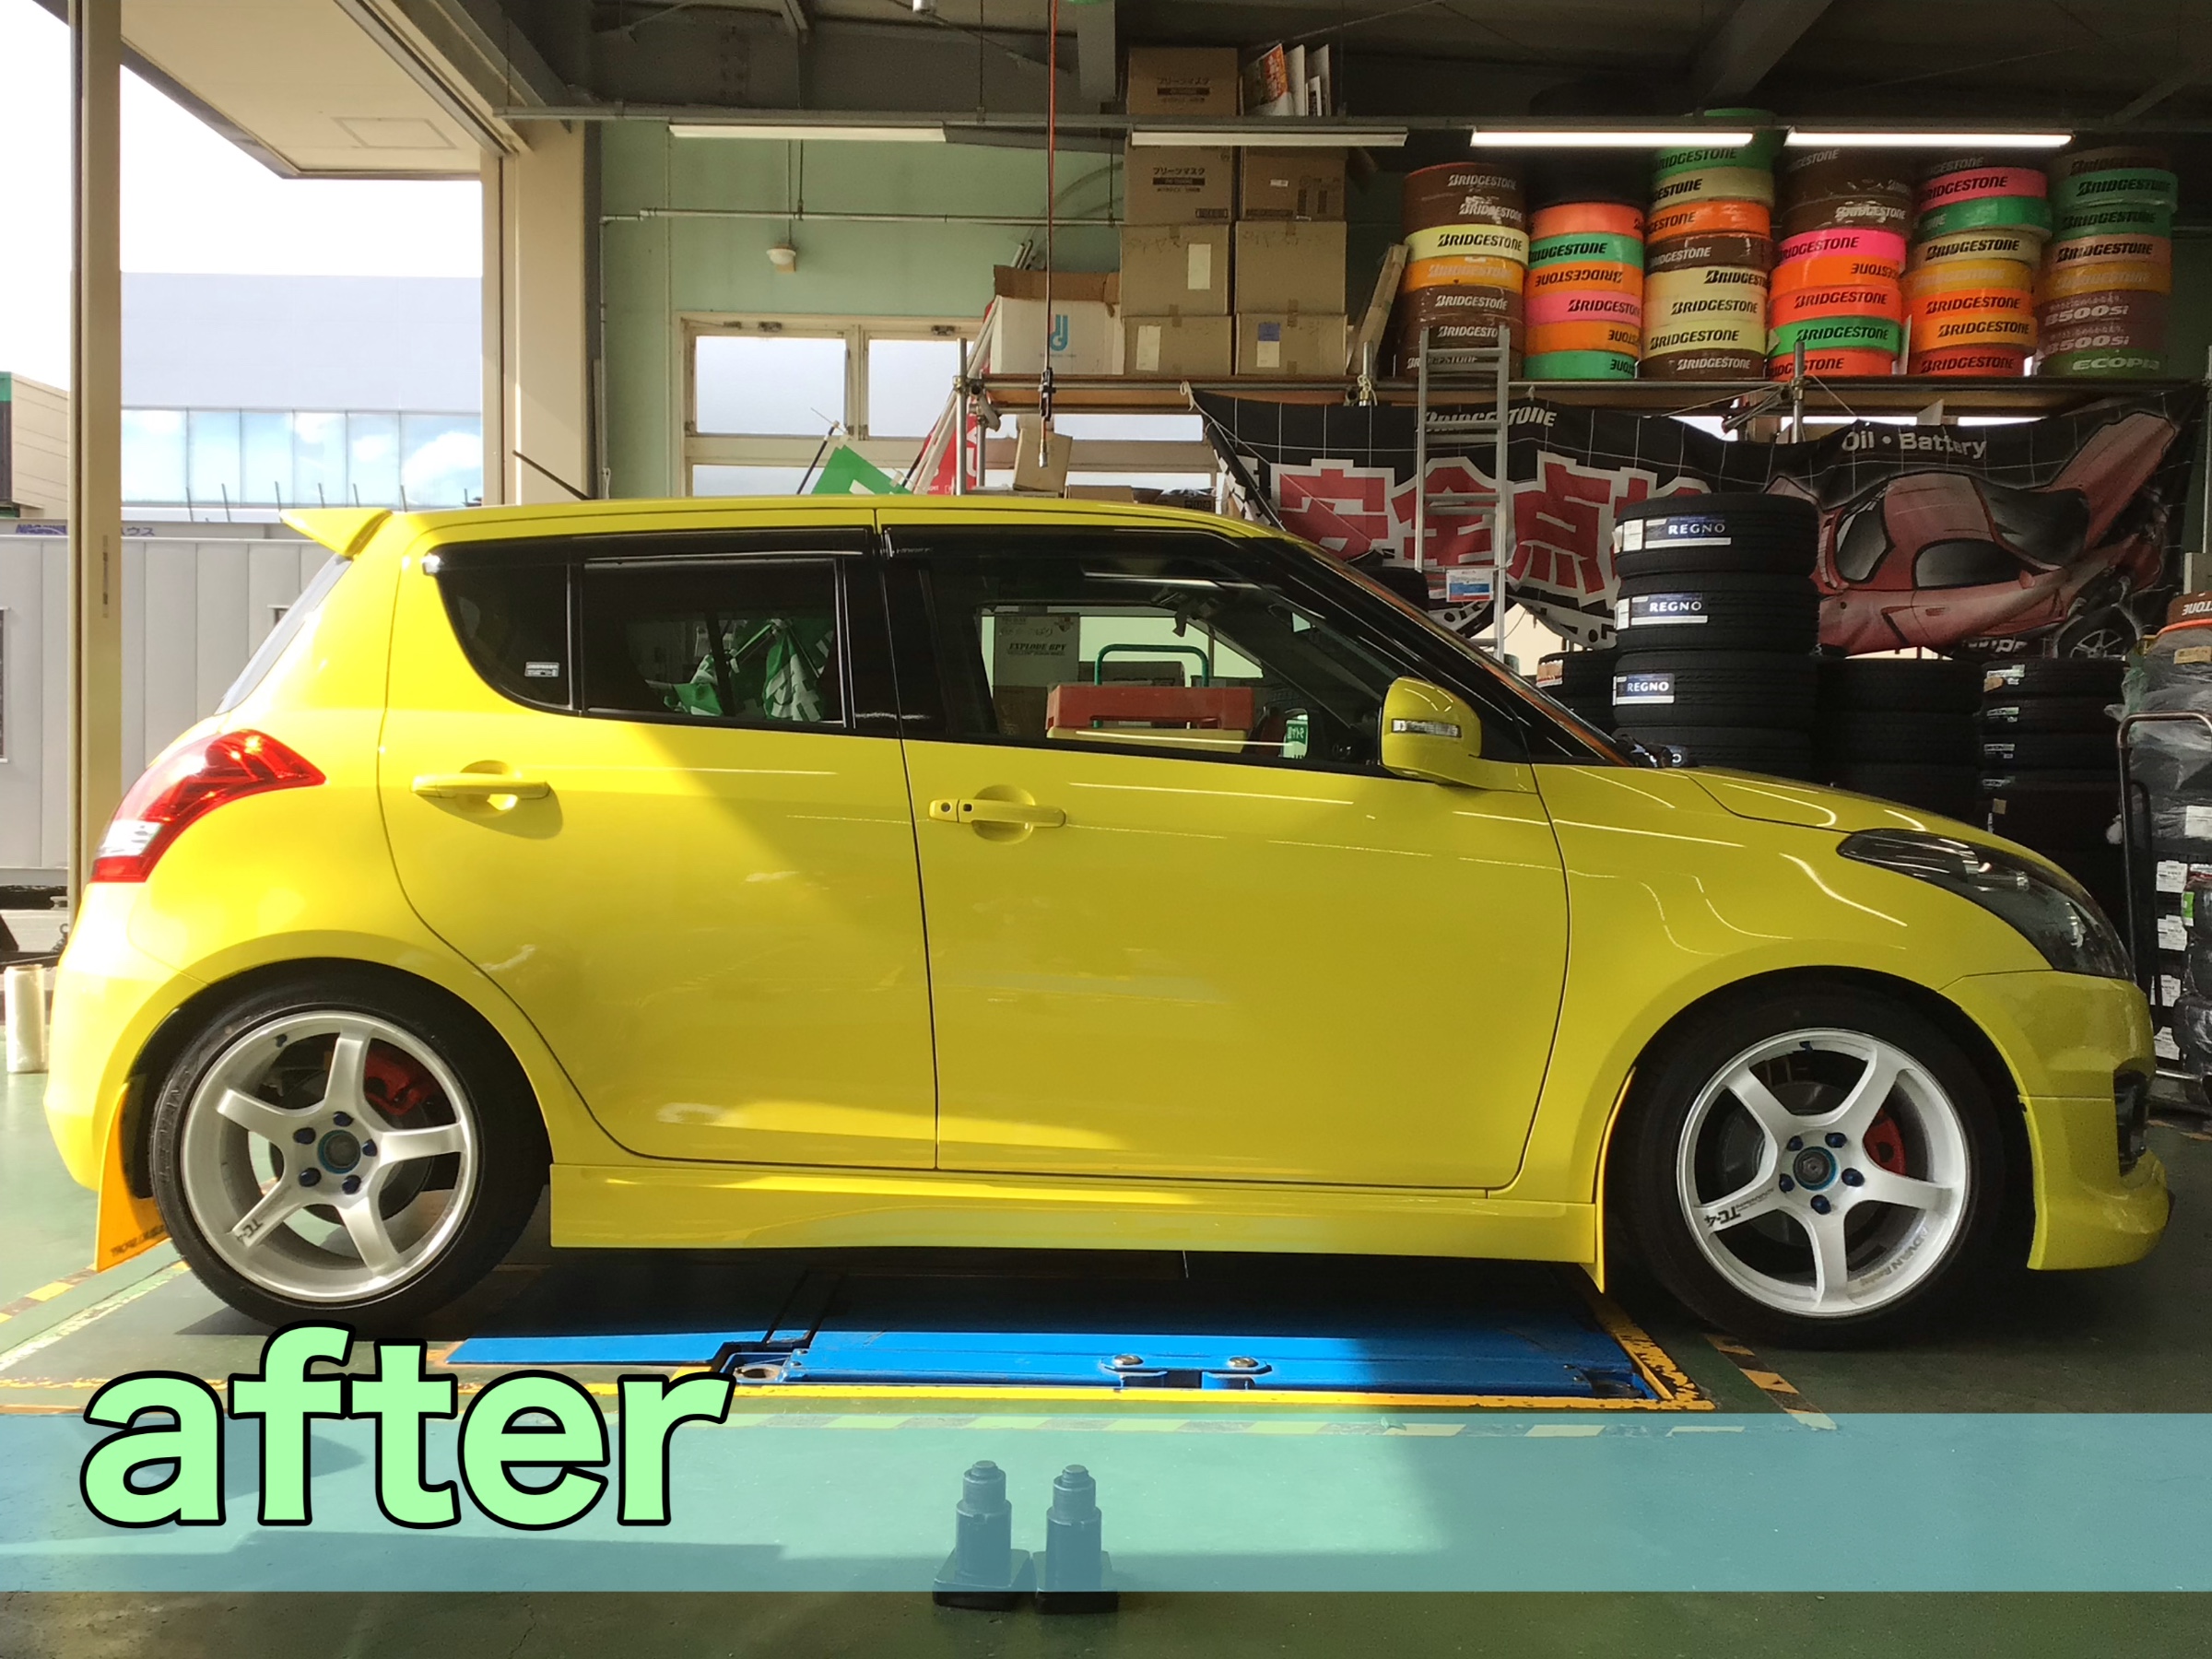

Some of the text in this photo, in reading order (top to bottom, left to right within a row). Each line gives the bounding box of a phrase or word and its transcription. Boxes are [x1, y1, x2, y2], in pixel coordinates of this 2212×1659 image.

[1656, 148, 1736, 170] RIDGESTONE
[1448, 174, 1517, 190] BRIDGESTONE
[1926, 176, 2008, 199] RIDGESTONE
[1438, 233, 1523, 252] BRIDGESTONE
[1781, 237, 1860, 259] RIDGESTONE
[1925, 239, 2020, 262] BRIDGESTONE
[2055, 241, 2154, 264] BRIDGESTONE
[1535, 269, 1624, 288] BRIDGESTONE
[1435, 295, 1508, 311] BRIDGESTONE
[1670, 300, 1759, 316] BRIDGESTONE
[1794, 291, 1888, 310] BRIDGESTONE
[1925, 296, 2021, 315] BRIDGESTONE
[1438, 325, 1499, 338] BRIDGESTO
[1796, 325, 1890, 343] BRIDGESTONE
[1937, 320, 2030, 339] BRIDGESTONE
[1650, 330, 1740, 351] BRIDGESTONE
[1677, 358, 1751, 371] BRIDGESTONE
[1920, 357, 2016, 374] BRIDGESTONE
[1841, 430, 1987, 459] Oil Battery
[1270, 453, 1691, 594] 安全点
[1668, 524, 1725, 535] REGNO
[1649, 601, 1702, 613] REGNO
[1627, 681, 1669, 692] REGNO
[1704, 1206, 1741, 1228] TC-4
